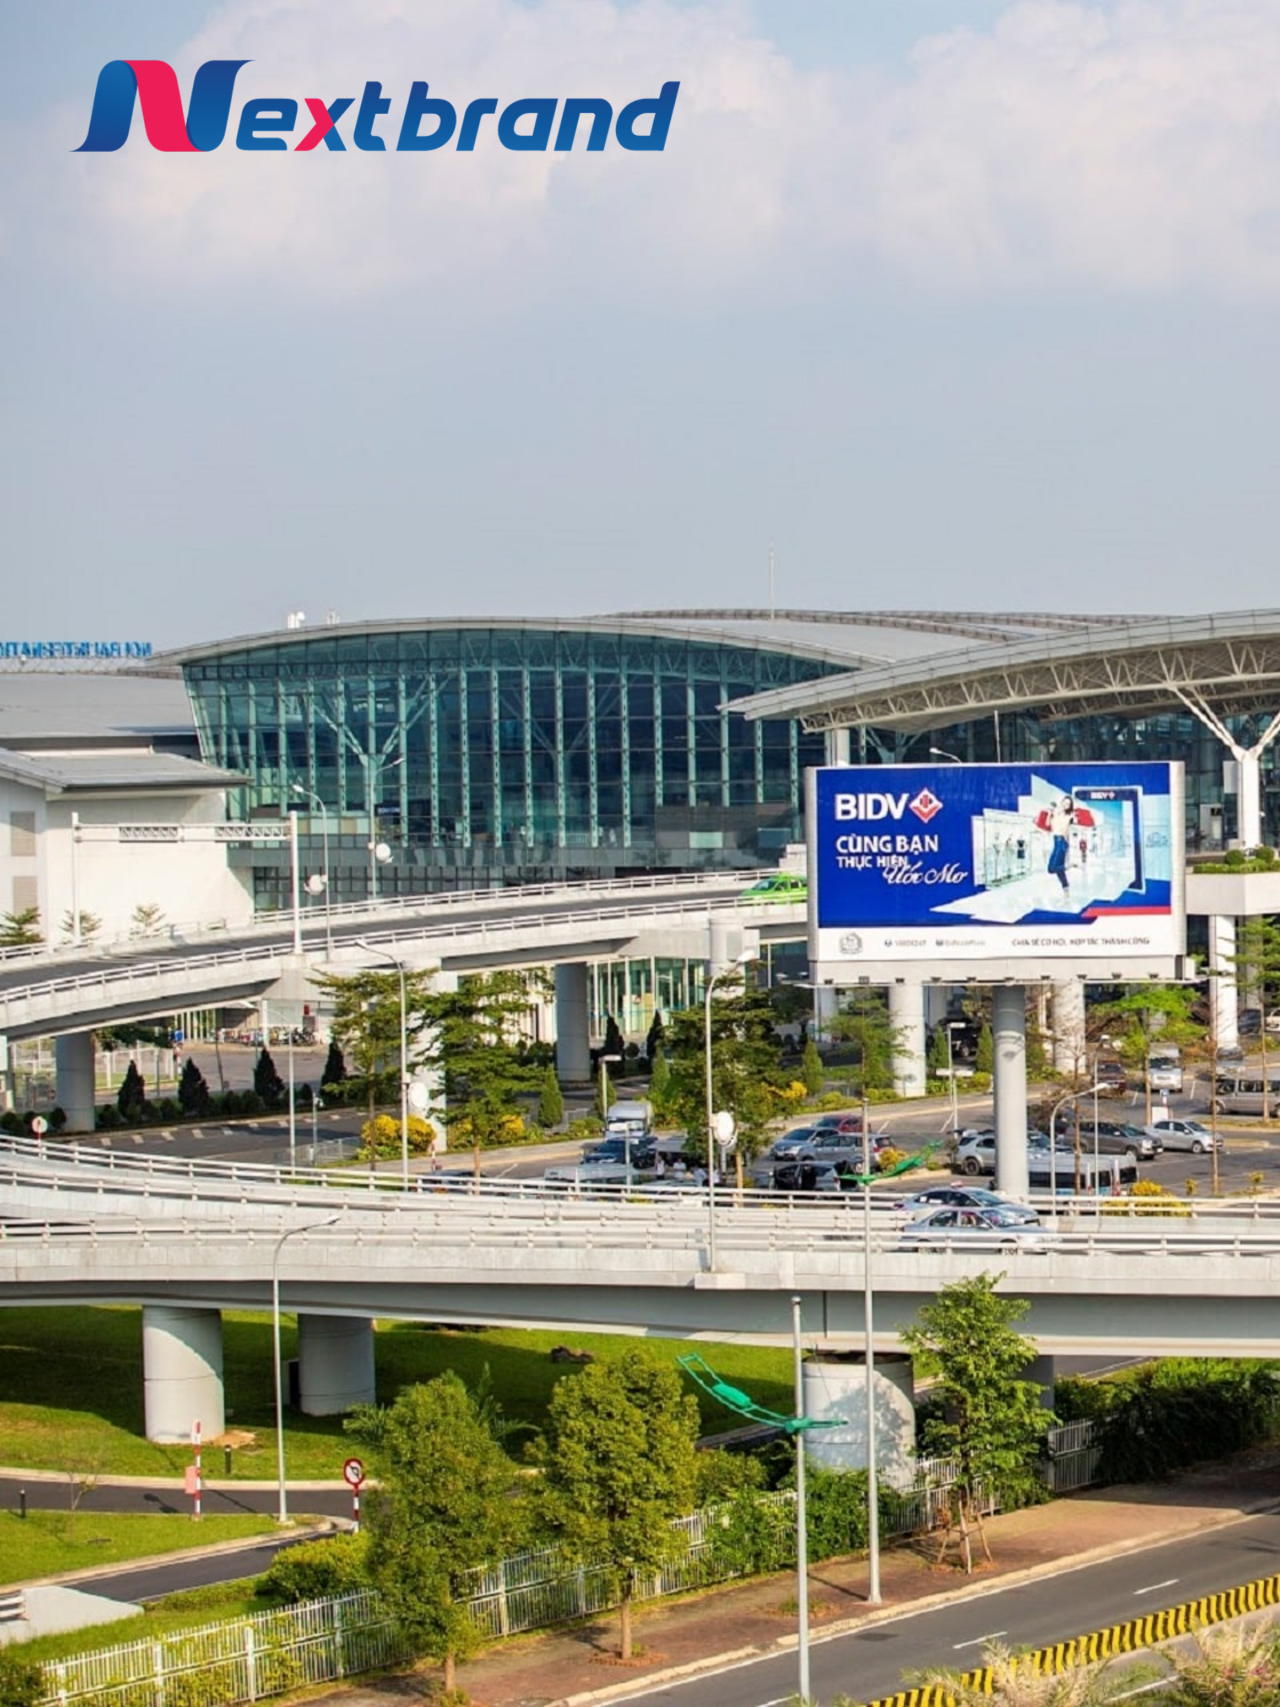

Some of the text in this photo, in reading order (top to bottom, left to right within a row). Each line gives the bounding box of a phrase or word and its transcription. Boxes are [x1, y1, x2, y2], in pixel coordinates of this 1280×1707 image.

[835, 793, 909, 821] BIDV
[836, 833, 939, 855] CÙNG BẠN
[836, 855, 873, 870] THỰC
